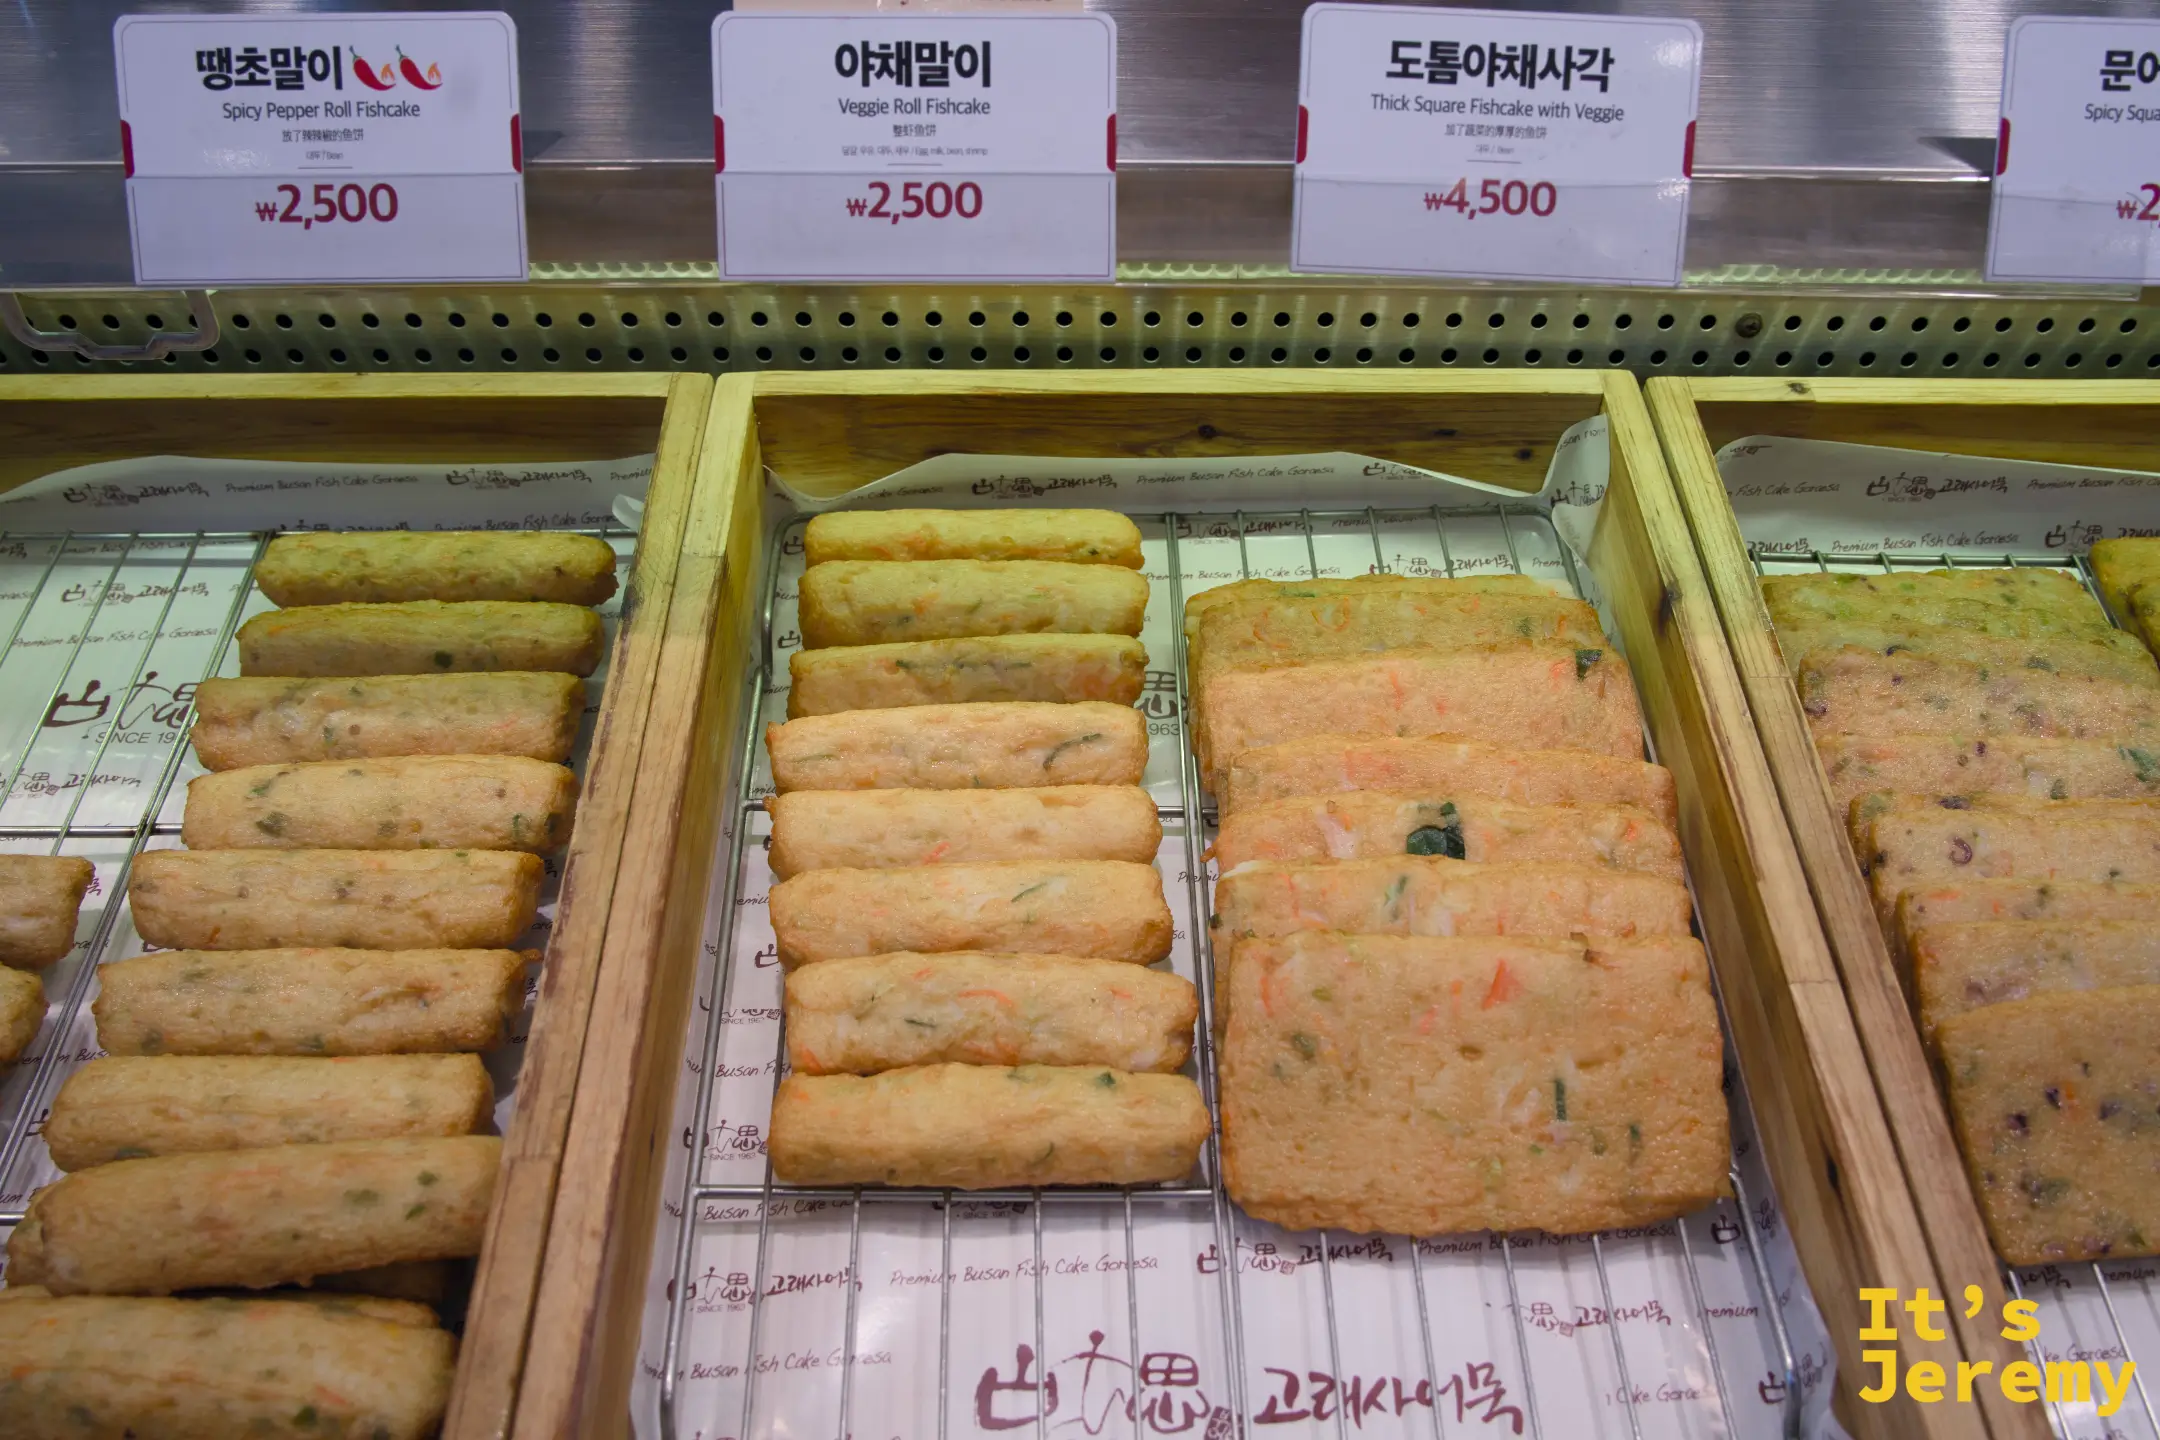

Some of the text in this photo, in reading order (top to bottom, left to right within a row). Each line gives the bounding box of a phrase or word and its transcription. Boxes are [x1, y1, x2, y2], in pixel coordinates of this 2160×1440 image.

[196, 45, 343, 91] 땡초말이
[834, 40, 991, 88] 야채말이
[1386, 40, 1615, 93] 도톰야채사각
[222, 100, 421, 121] Spicy Pepper Roll Fishcake
[838, 98, 991, 117] Veggie Roll Fishcake
[1371, 93, 1625, 123] Thick Square Fishcake with Veggie
[2084, 103, 2123, 123] Spicy
[255, 183, 398, 230] ₩2,500
[846, 181, 983, 225] ₩2,500
[1424, 178, 1557, 220] ₩4,500
[226, 482, 274, 493] Premium
[277, 479, 311, 490] Busan
[315, 476, 340, 488] Fish
[343, 475, 369, 486] Cake
[1136, 465, 1335, 484] Premium Busan Fish Cake Goraesa
[2027, 478, 2076, 489] Premium
[1736, 481, 1840, 496] Fish Cake Goraesa
[1832, 539, 1878, 552] Premium
[1883, 536, 1917, 550] Busan
[1921, 532, 1943, 547] Fish
[1947, 531, 1971, 546] Cake
[1198, 568, 1234, 580] Busan
[1265, 565, 1291, 577] Cake
[108, 630, 136, 642] Fish
[716, 1063, 758, 1078] Busan
[704, 1204, 749, 1220] Busan
[793, 1198, 828, 1213] Cake
[1419, 1239, 1482, 1254] Premium
[1540, 1230, 1571, 1246] Fish
[964, 1264, 1010, 1282] Busan
[1055, 1253, 1090, 1274] Cake
[690, 1363, 738, 1381] Busan
[785, 1351, 820, 1371] Cake
[1253, 1361, 1524, 1436] 고래사어묵
